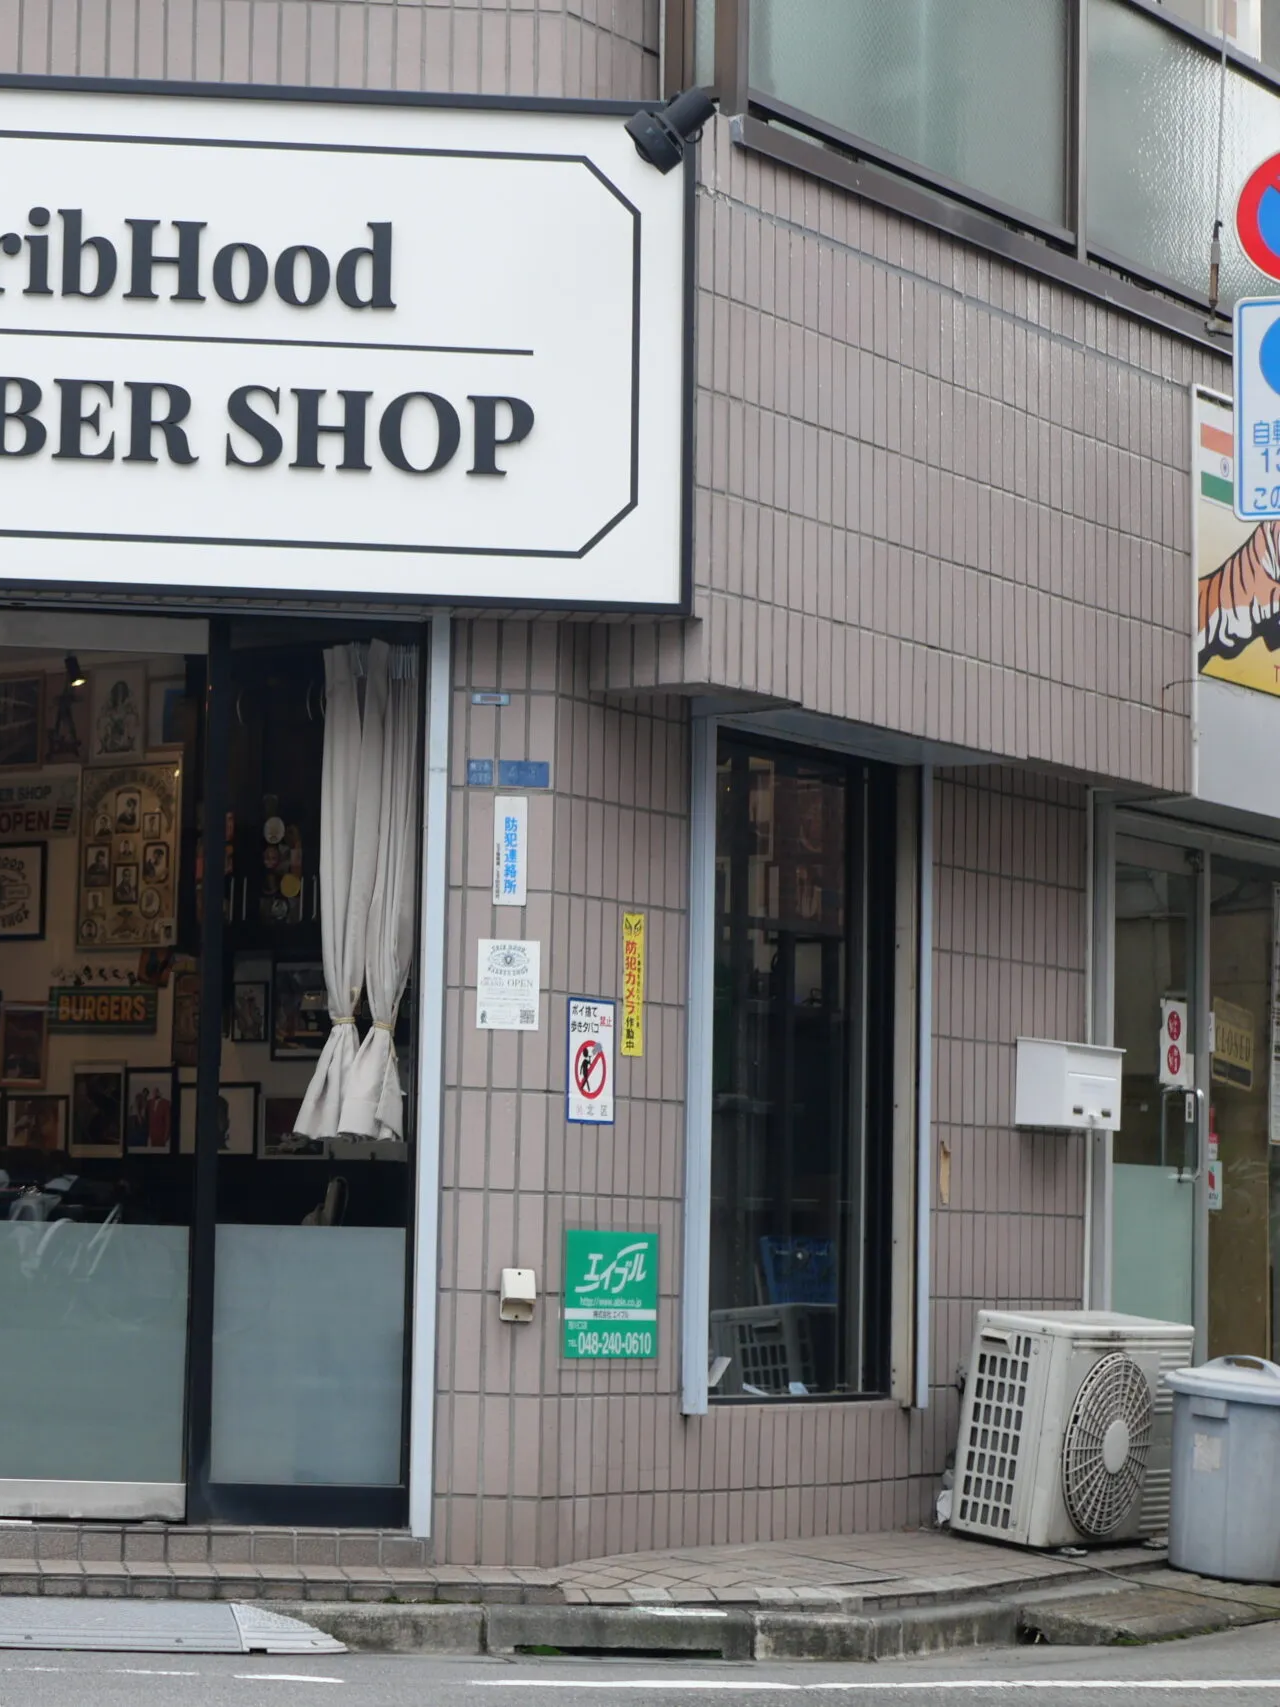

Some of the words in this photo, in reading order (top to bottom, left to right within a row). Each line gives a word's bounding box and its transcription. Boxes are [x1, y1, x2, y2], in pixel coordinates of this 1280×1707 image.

[225, 384, 535, 477] SHOP
[18, 785, 52, 801] SHOP
[503, 816, 519, 895] 防犯連絡所
[507, 978, 534, 988] OPEN
[58, 994, 147, 1023] BURGERS
[571, 1004, 598, 1018] ポイ捨て
[570, 1021, 600, 1034] 歩きタバコ
[600, 1015, 612, 1026] 禁止
[1215, 1024, 1251, 1062] CLOSED
[578, 1331, 652, 1355] 048-240-0610
